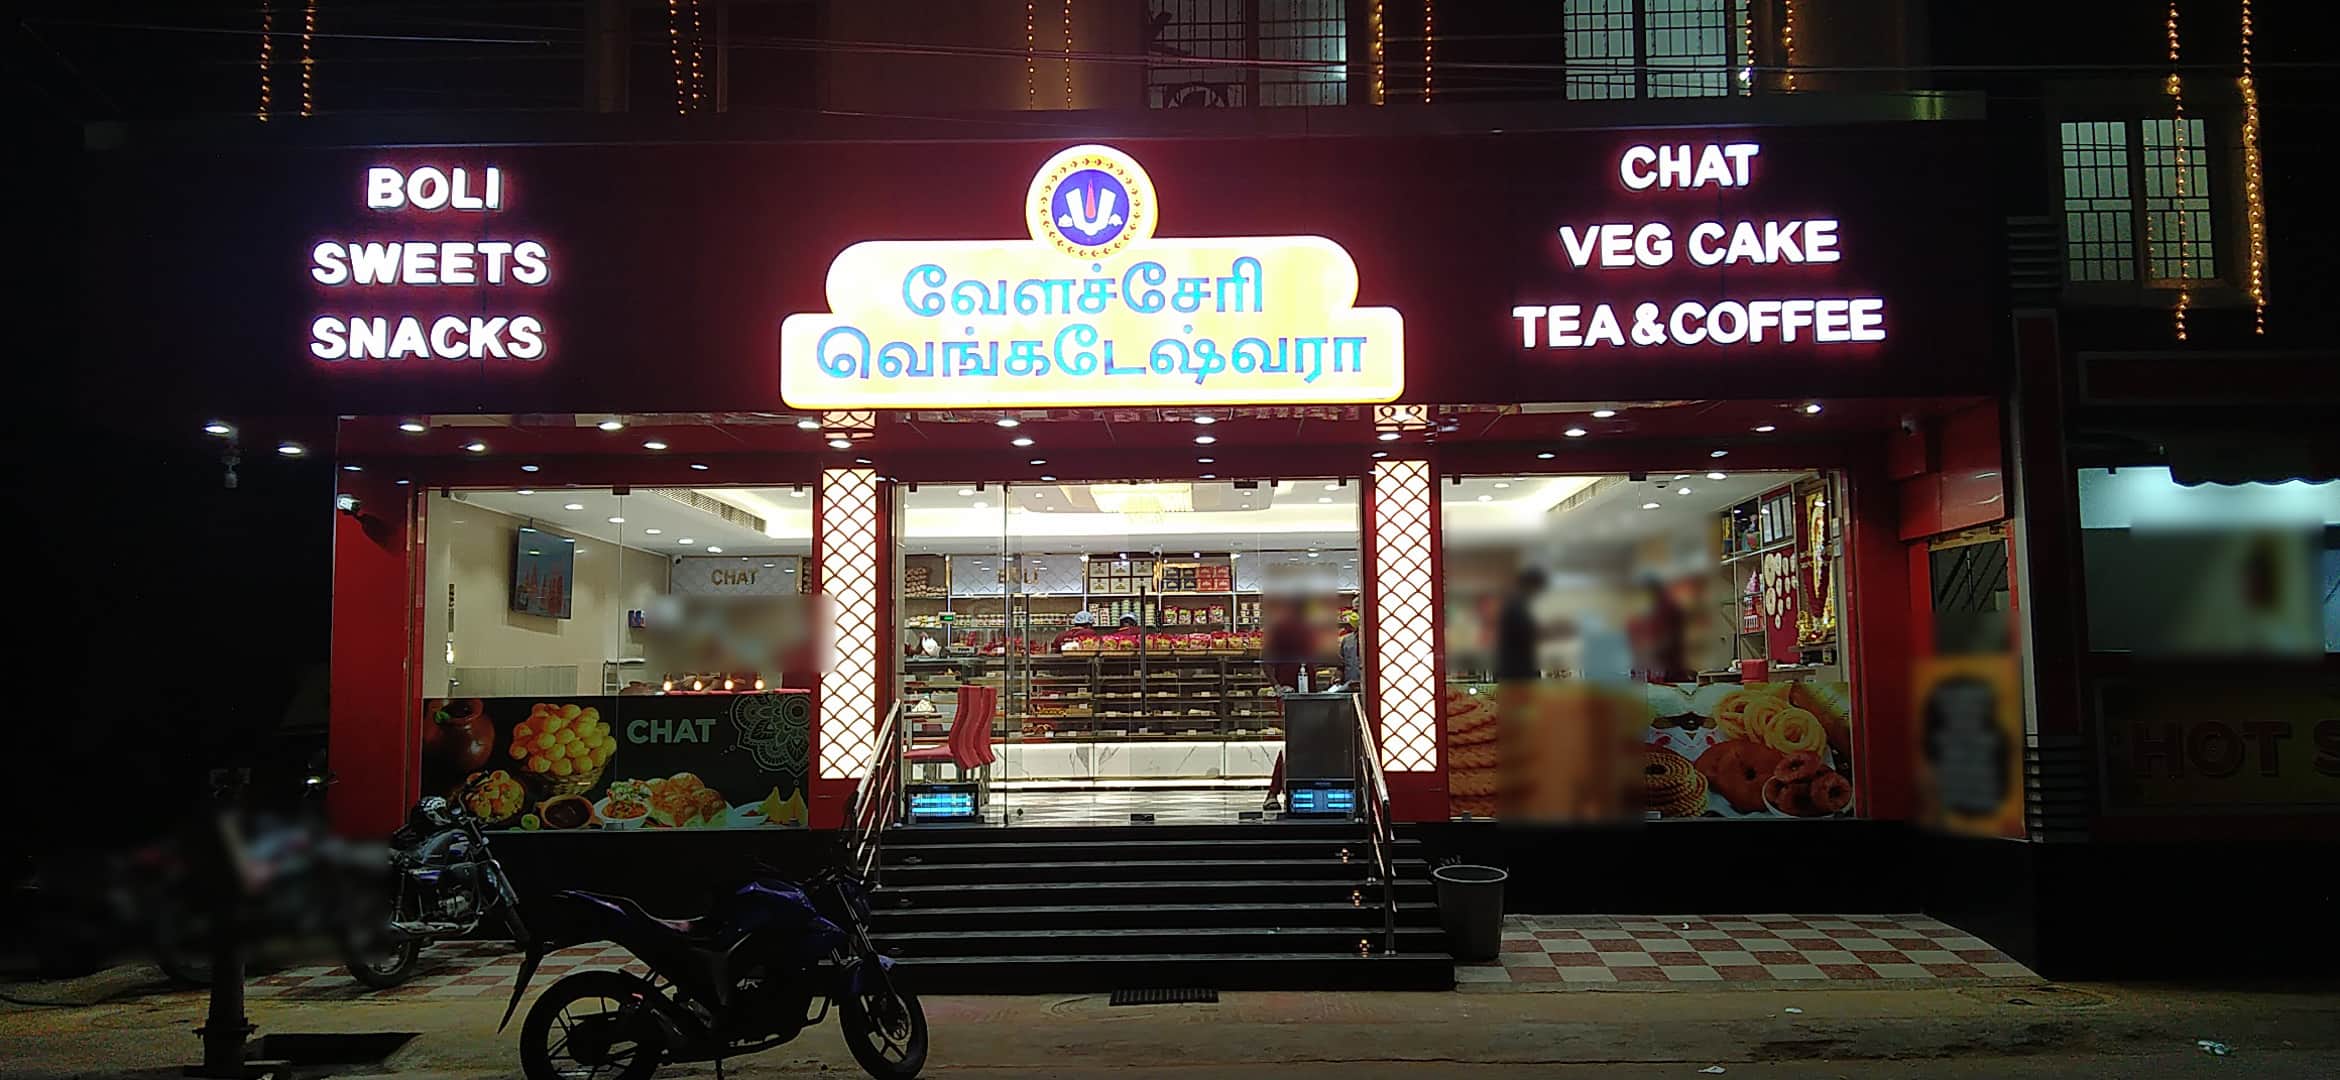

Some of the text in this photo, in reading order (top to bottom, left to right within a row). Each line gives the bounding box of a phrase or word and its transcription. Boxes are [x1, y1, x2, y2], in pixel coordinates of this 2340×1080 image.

[367, 166, 502, 210] BOLI
[1620, 144, 1759, 190] CHAT
[310, 242, 550, 285] SWEETS
[1560, 220, 1841, 267] VEG CAKE
[902, 256, 1263, 317] வேளச்சேரி
[310, 315, 547, 360] SNACKS
[816, 323, 1367, 385] வெங்கடேஷ்வரா
[711, 568, 760, 586] CHAT
[626, 719, 717, 744] CHAT
[2129, 720, 2291, 778] HOT
